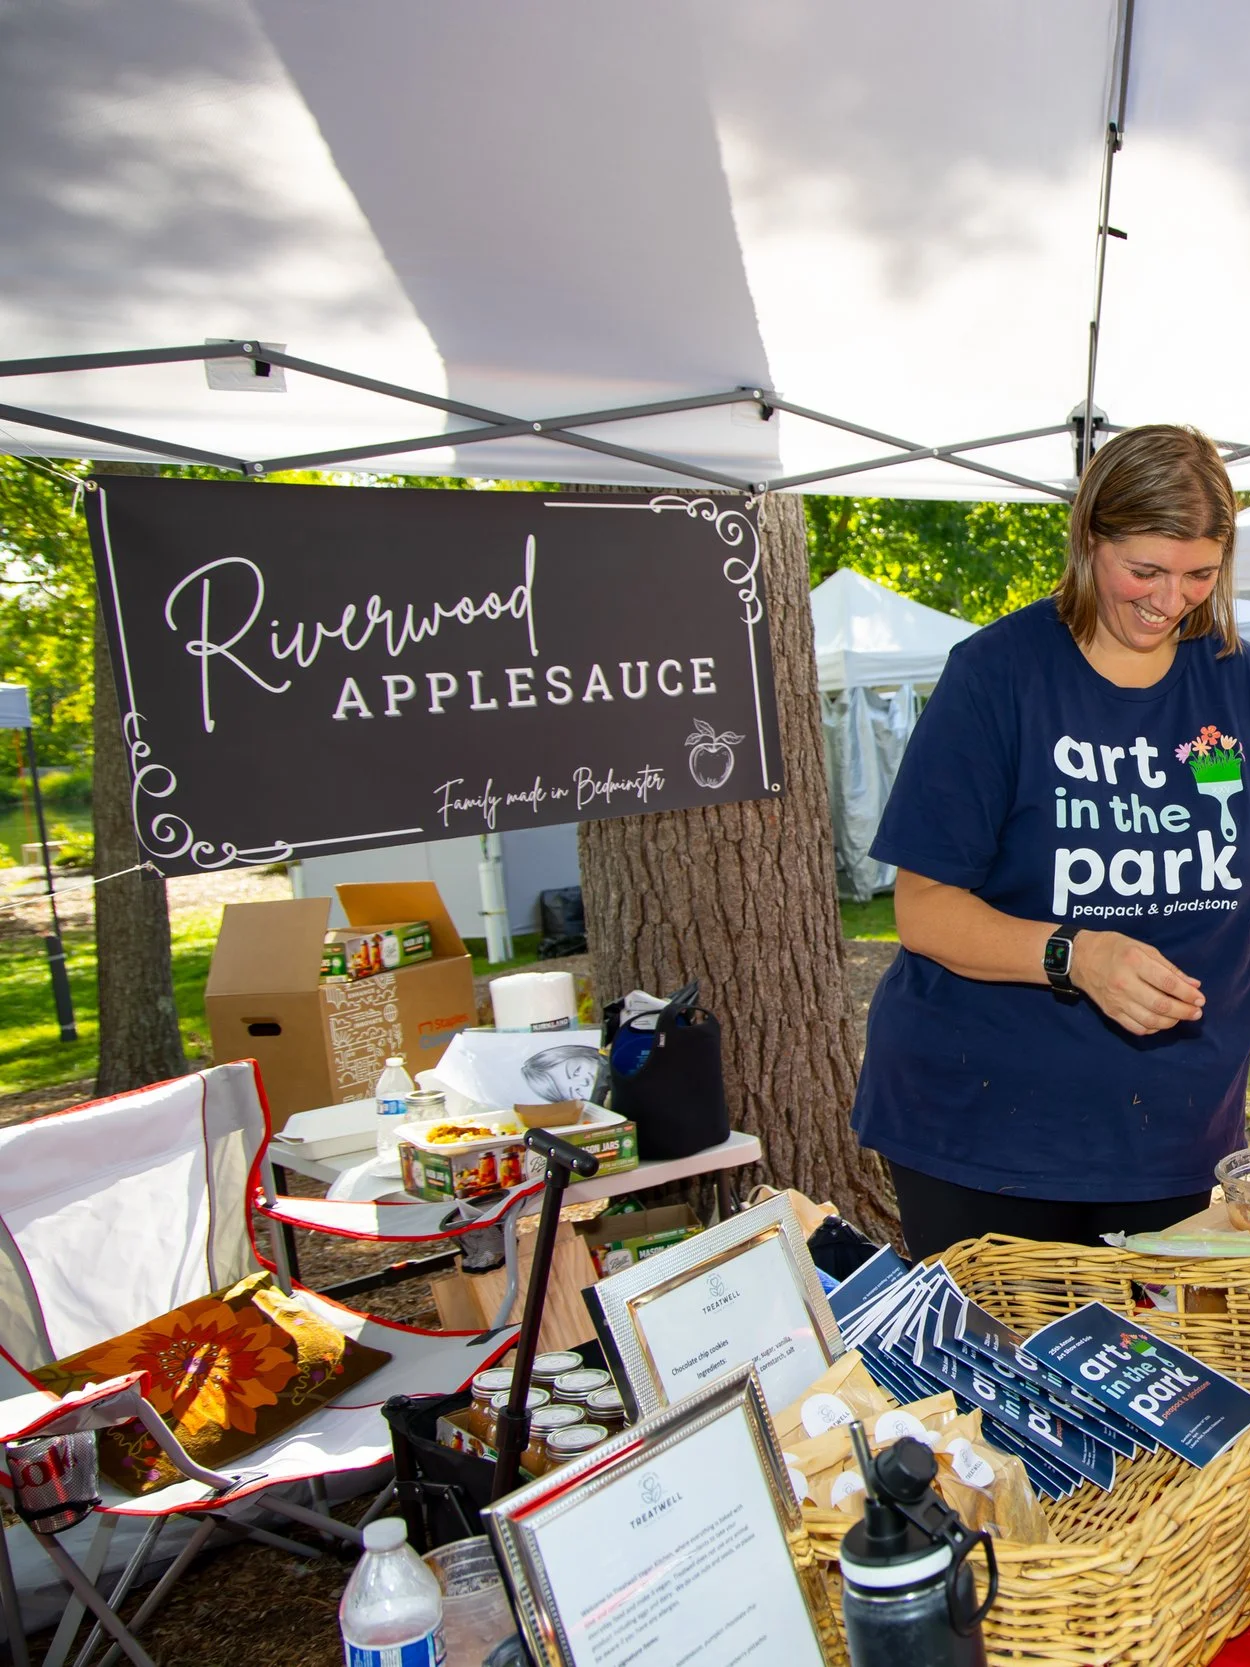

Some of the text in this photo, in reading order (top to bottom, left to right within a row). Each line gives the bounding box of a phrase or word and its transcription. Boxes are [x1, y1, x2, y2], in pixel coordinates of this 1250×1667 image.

[165, 534, 538, 733] Riverwood
[332, 656, 718, 721] APPLESAUCE
[1053, 735, 1166, 788] art
[433, 764, 665, 829] Family made in Bedminster
[1055, 787, 1191, 834] in the
[1052, 830, 1243, 916] park
[1073, 899, 1238, 919] peapack & gladstone
[434, 1013, 469, 1029] Staples
[581, 1140, 620, 1154] ASON JARS
[702, 1290, 741, 1315] TREATWELL
[671, 1339, 729, 1376] Chocolate chip cookies
[697, 1358, 727, 1379] Ingredients:
[760, 1346, 795, 1372] cornstarch, salt
[761, 1346, 776, 1359] sugar,
[1057, 1352, 1067, 1361] Art
[1079, 1343, 1132, 1381] art
[972, 1370, 996, 1400] ar
[1101, 1362, 1157, 1400] in the
[1128, 1367, 1199, 1427] park
[1161, 1401, 1183, 1420] peapack
[629, 1492, 684, 1529] TREATWELL
